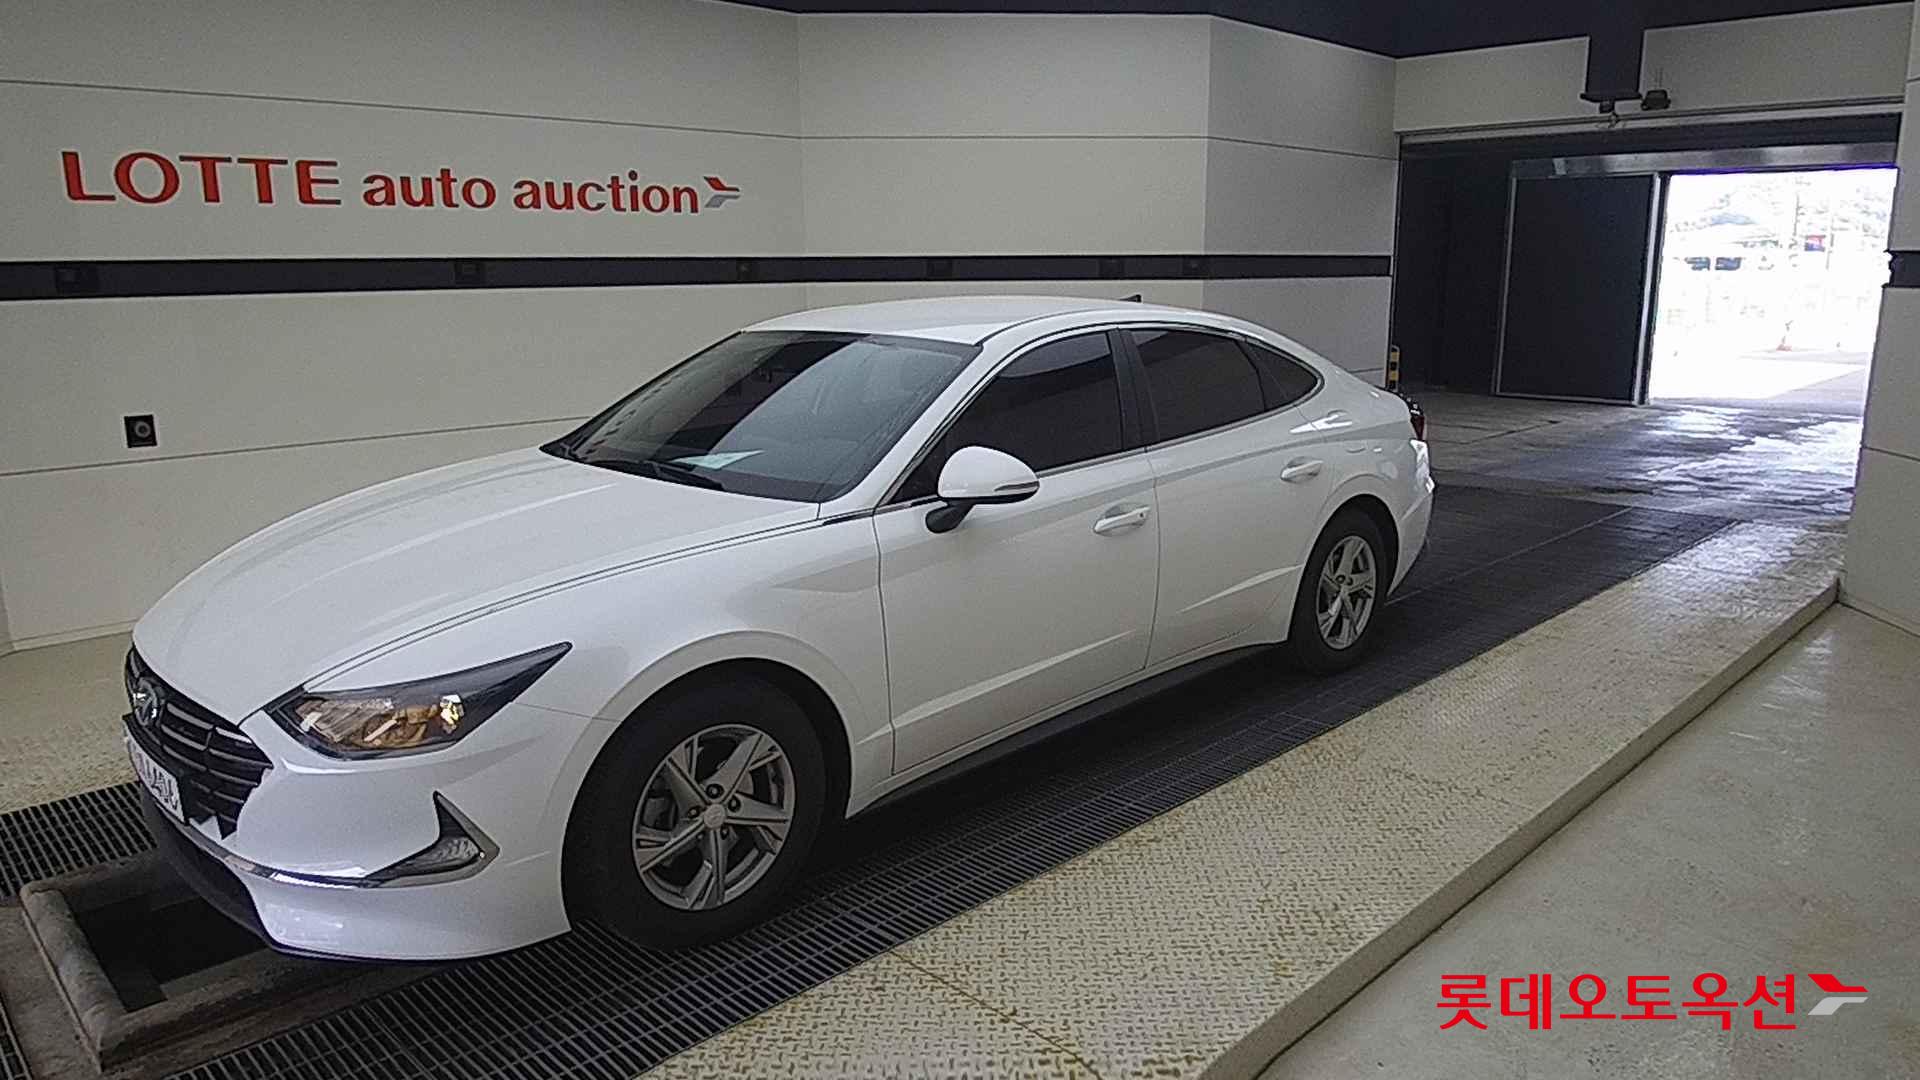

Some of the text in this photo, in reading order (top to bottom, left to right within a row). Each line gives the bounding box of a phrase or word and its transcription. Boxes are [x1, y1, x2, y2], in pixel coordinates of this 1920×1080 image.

[62, 151, 699, 214] LOTTE auto auction
